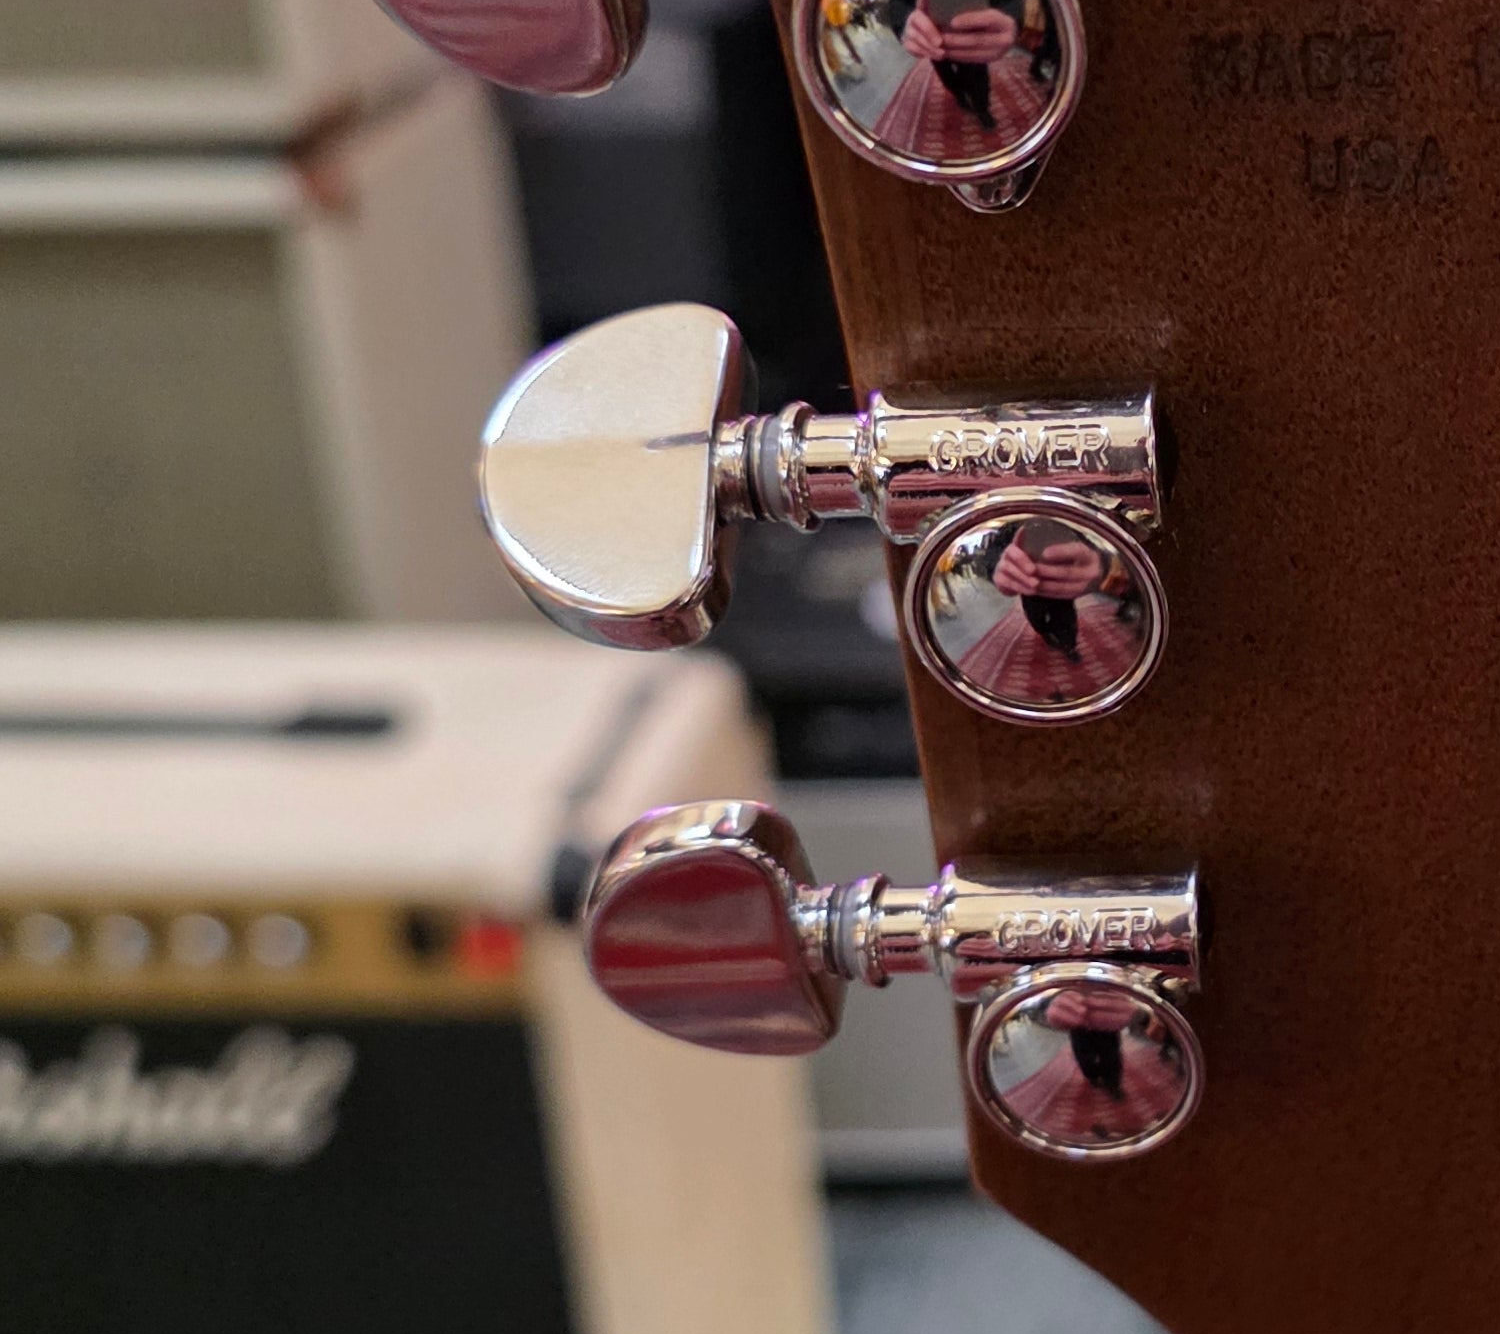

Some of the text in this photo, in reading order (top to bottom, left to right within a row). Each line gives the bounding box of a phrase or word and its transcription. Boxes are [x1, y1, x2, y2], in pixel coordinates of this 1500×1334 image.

[1297, 130, 1450, 204] USA
[928, 424, 1111, 475] GROVER
[993, 906, 1159, 956] GROVER
